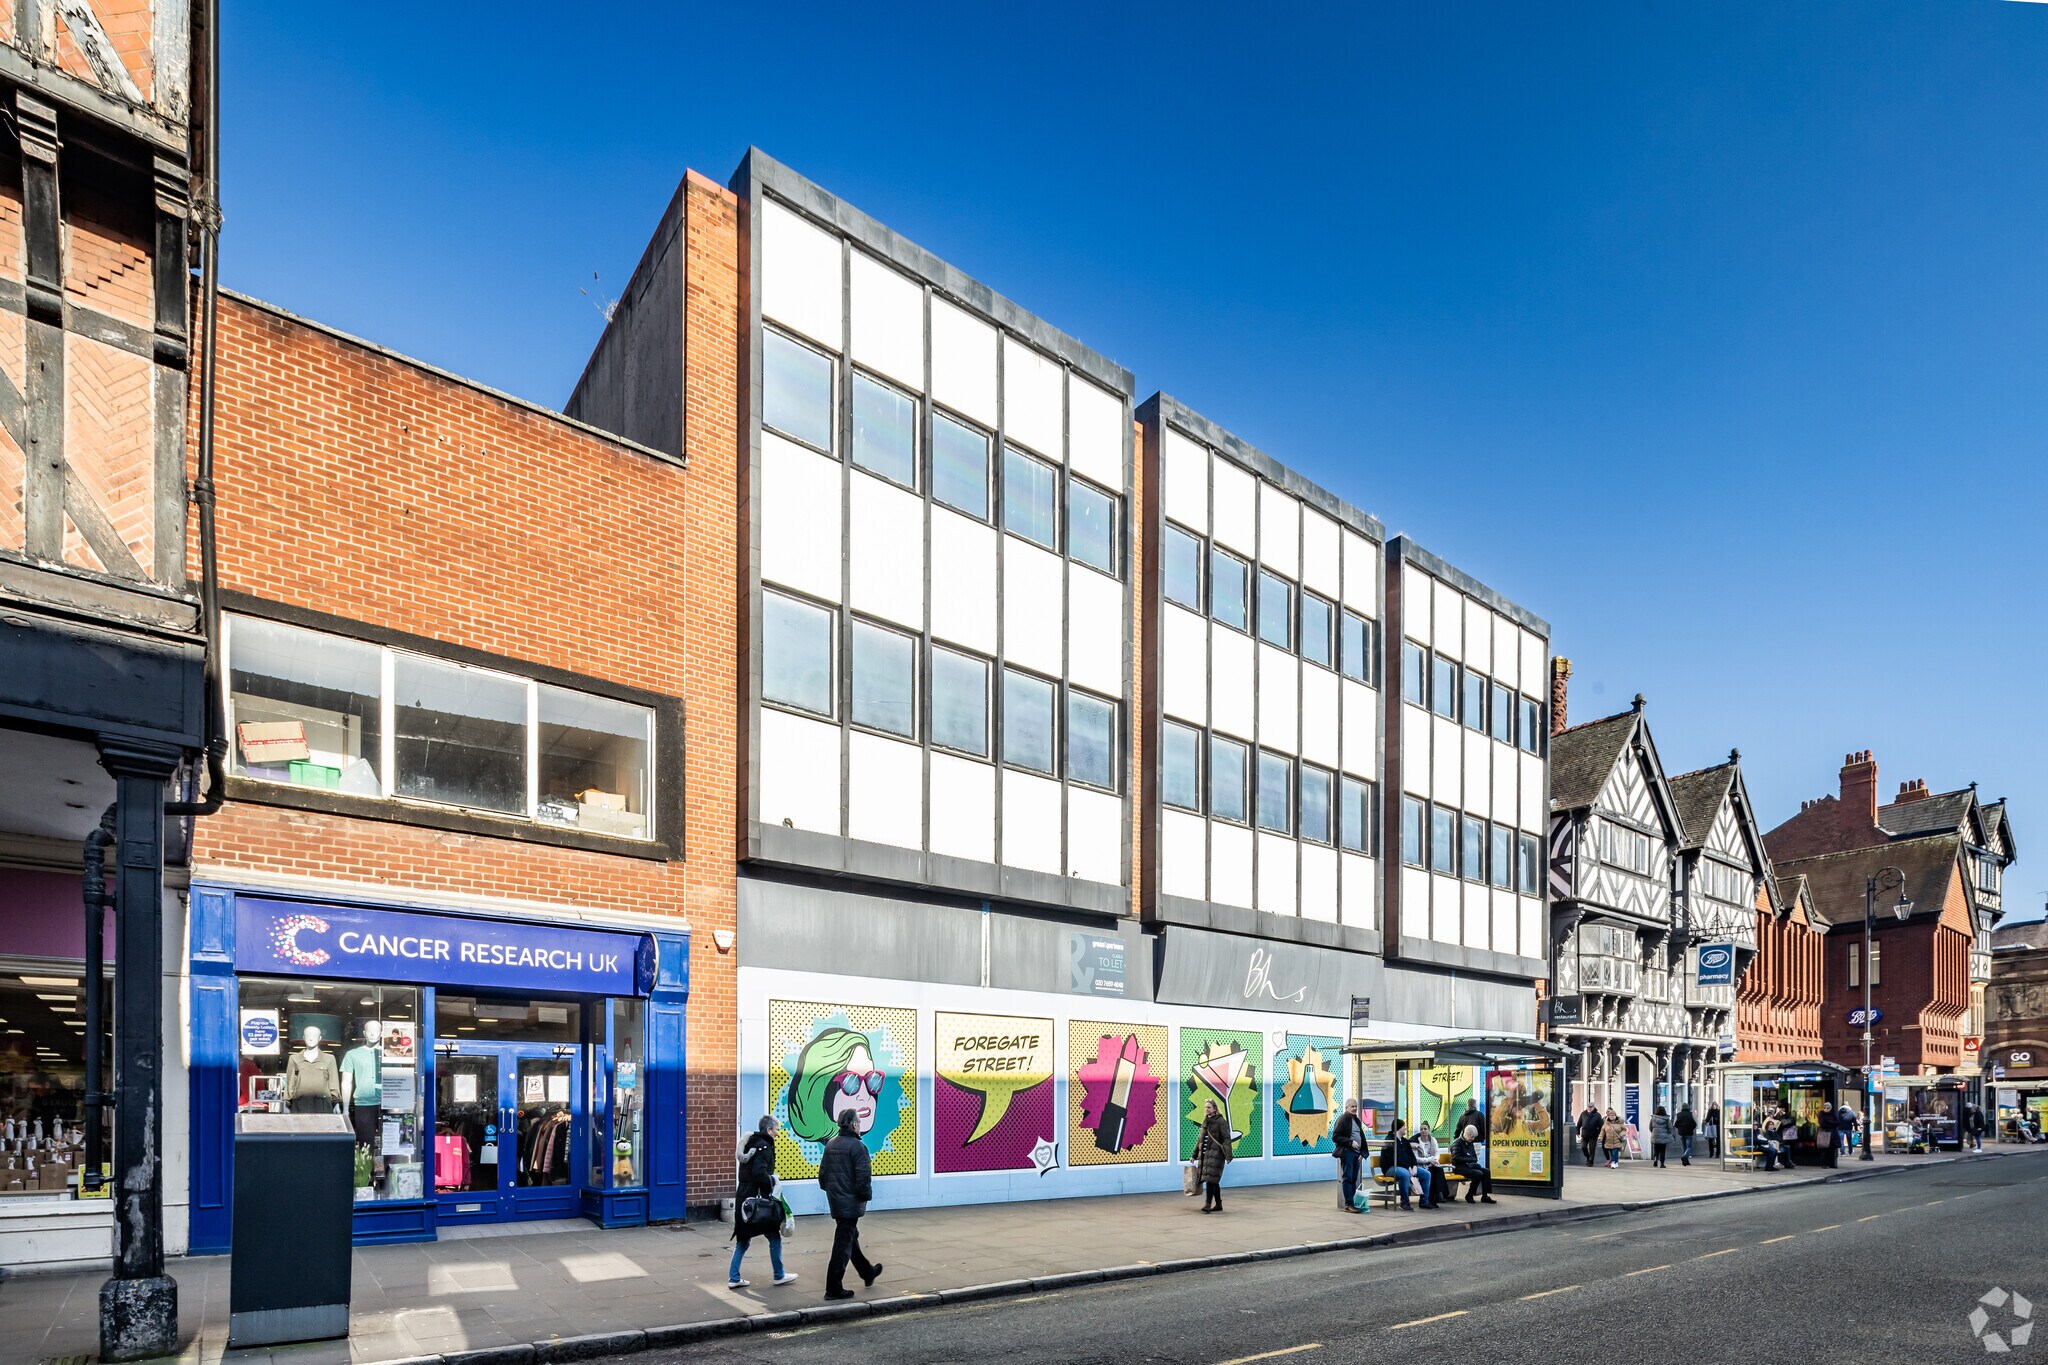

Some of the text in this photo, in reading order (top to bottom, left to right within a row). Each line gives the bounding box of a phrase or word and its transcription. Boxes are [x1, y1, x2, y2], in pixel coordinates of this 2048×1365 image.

[339, 931, 618, 973] CANCER RESEARCH UK
[1098, 956, 1124, 969] TO LET
[1699, 973, 1729, 981] pharmacy
[1848, 1009, 1878, 1024] Bots
[954, 1035, 1040, 1051] FOREGATE
[2010, 1052, 2031, 1061] GO
[962, 1055, 1033, 1073] STREET!
[1432, 1071, 1463, 1083] STREET!
